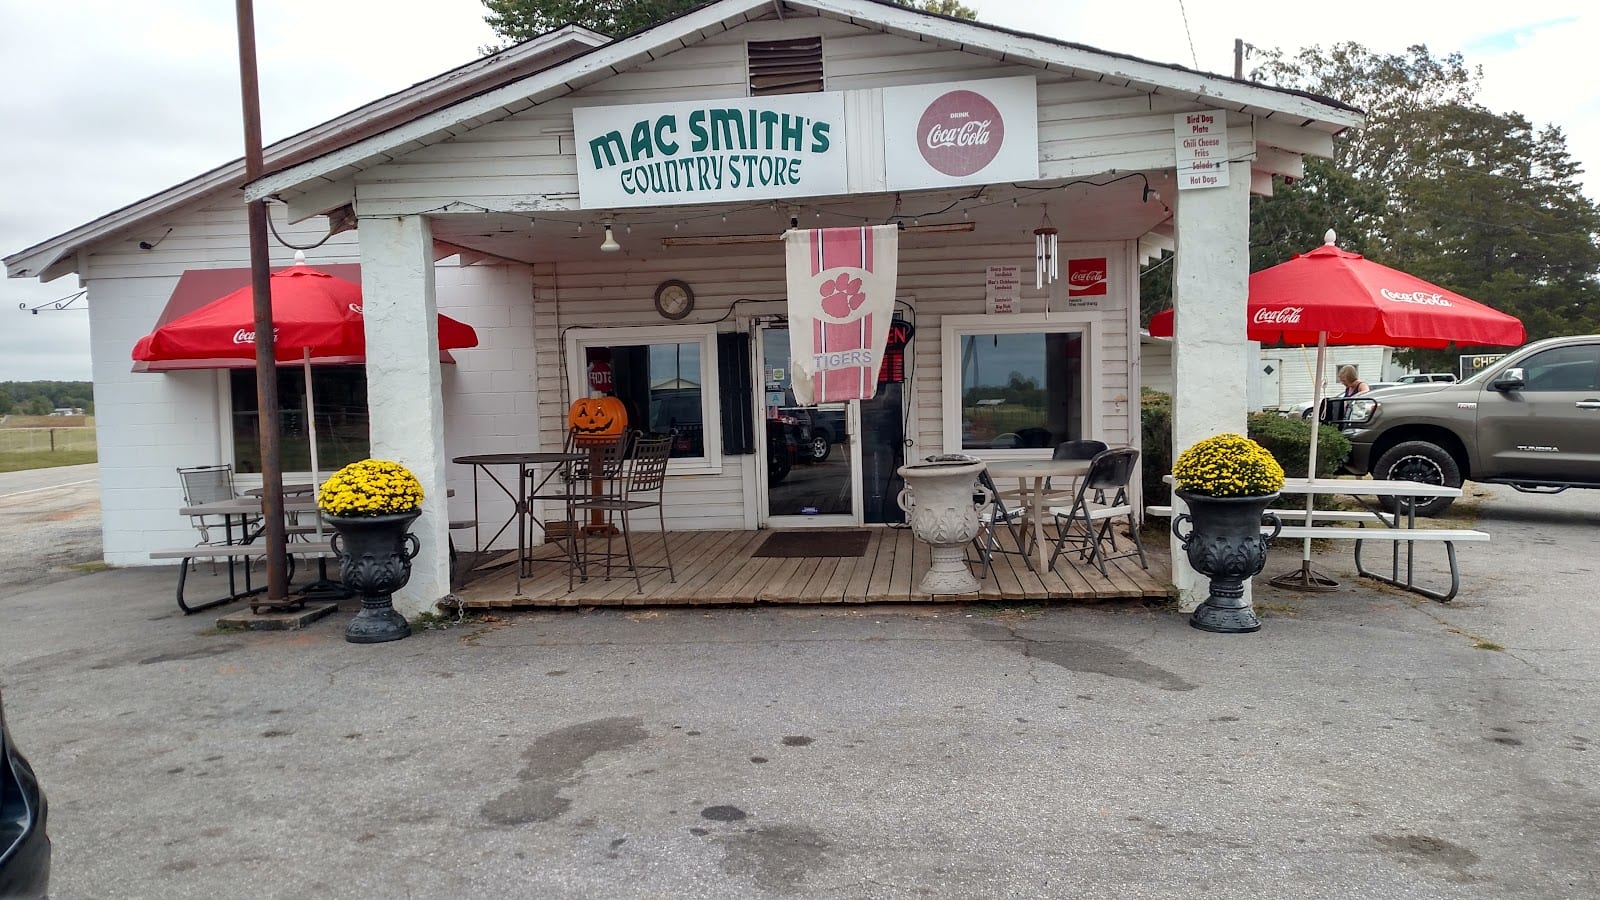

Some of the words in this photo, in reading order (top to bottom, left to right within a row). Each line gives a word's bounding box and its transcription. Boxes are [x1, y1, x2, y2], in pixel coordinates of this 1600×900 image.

[950, 111, 970, 119] DRINK
[1186, 114, 1200, 124] Bird
[1201, 114, 1214, 124] Dog
[927, 119, 992, 149] Coca-Cola
[1192, 124, 1209, 134] Plate
[589, 114, 679, 170] MAC
[688, 108, 831, 153] SMITH'S
[1183, 138, 1197, 148] Chili
[1198, 137, 1220, 147] Cheese
[1194, 149, 1210, 157] Fries
[1192, 160, 1213, 170] Salads
[620, 156, 725, 195] COUNTRY
[728, 154, 802, 189] STORE
[1190, 176, 1201, 185] Hot
[1202, 175, 1218, 185] Dogs
[1380, 287, 1453, 307] Coca-Cola
[1253, 307, 1304, 324] Coca-Cola
[813, 351, 872, 369] TIGERS
